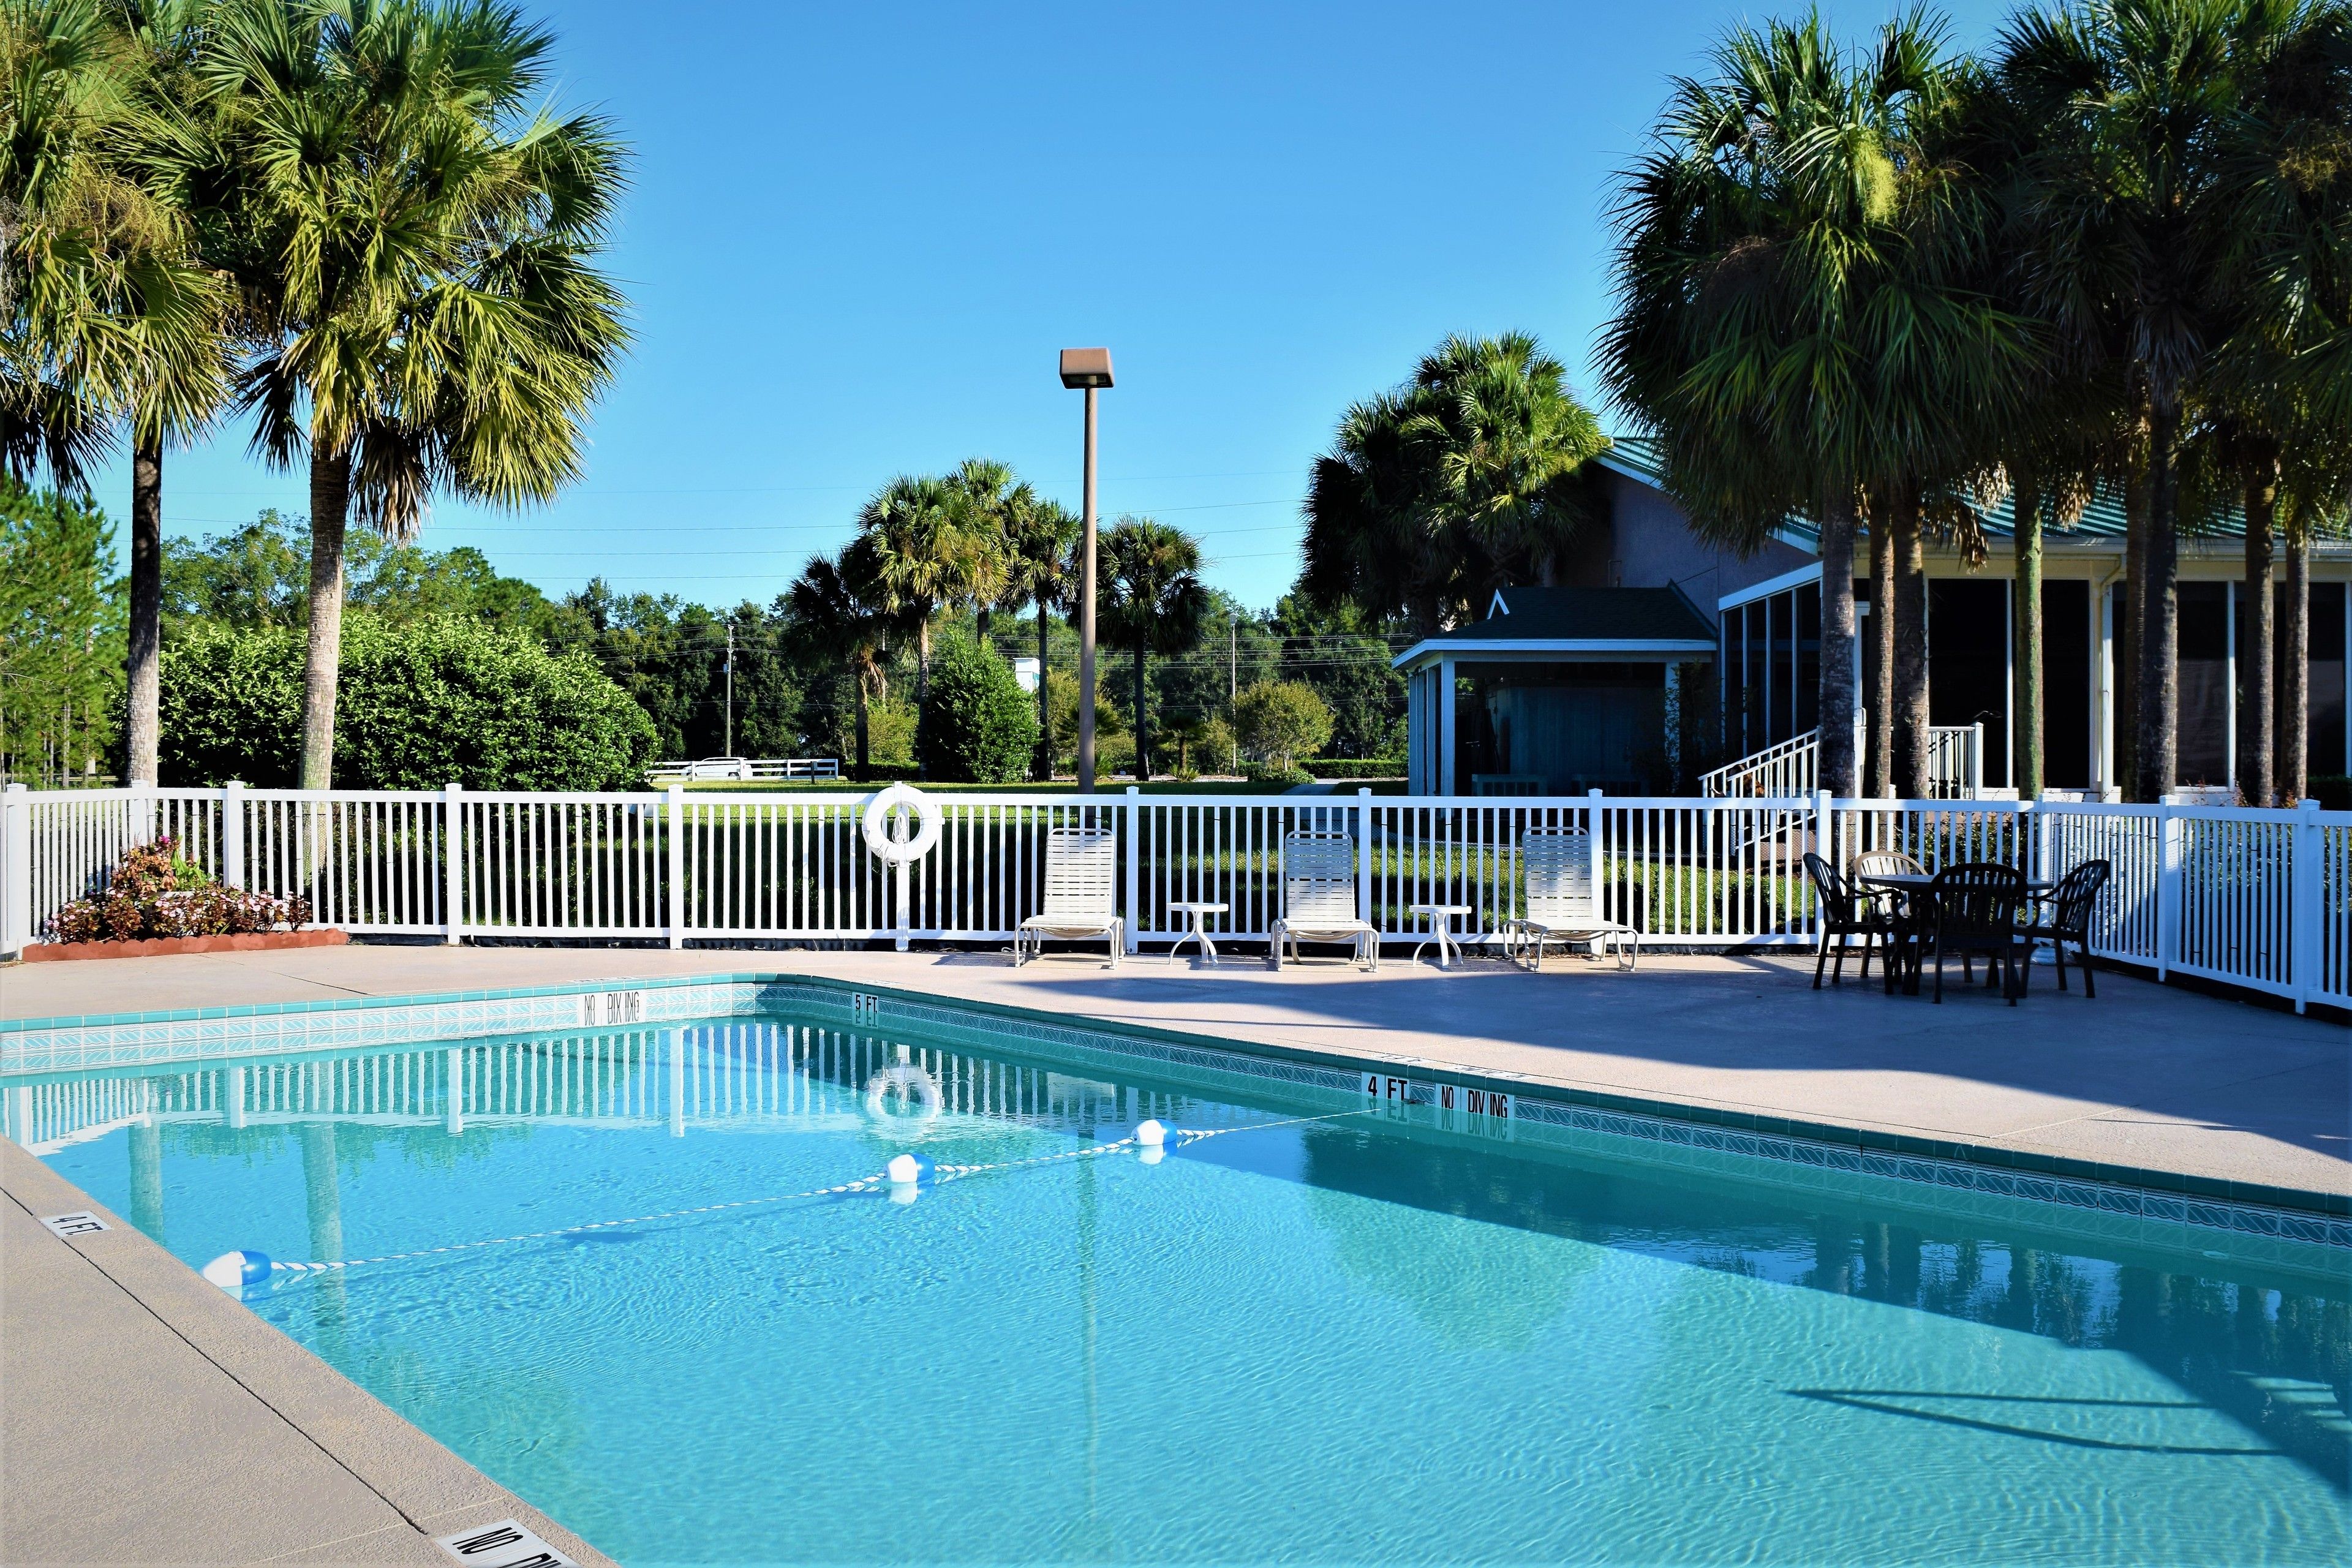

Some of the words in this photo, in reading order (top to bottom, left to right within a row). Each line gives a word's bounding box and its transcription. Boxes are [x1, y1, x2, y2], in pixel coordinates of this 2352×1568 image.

[585, 995, 595, 1011] NO
[856, 994, 861, 1010] 5
[1368, 1076, 1378, 1096] 4
[1387, 1078, 1408, 1101] FT
[1441, 1086, 1454, 1109] NO
[452, 1527, 524, 1555] NO
